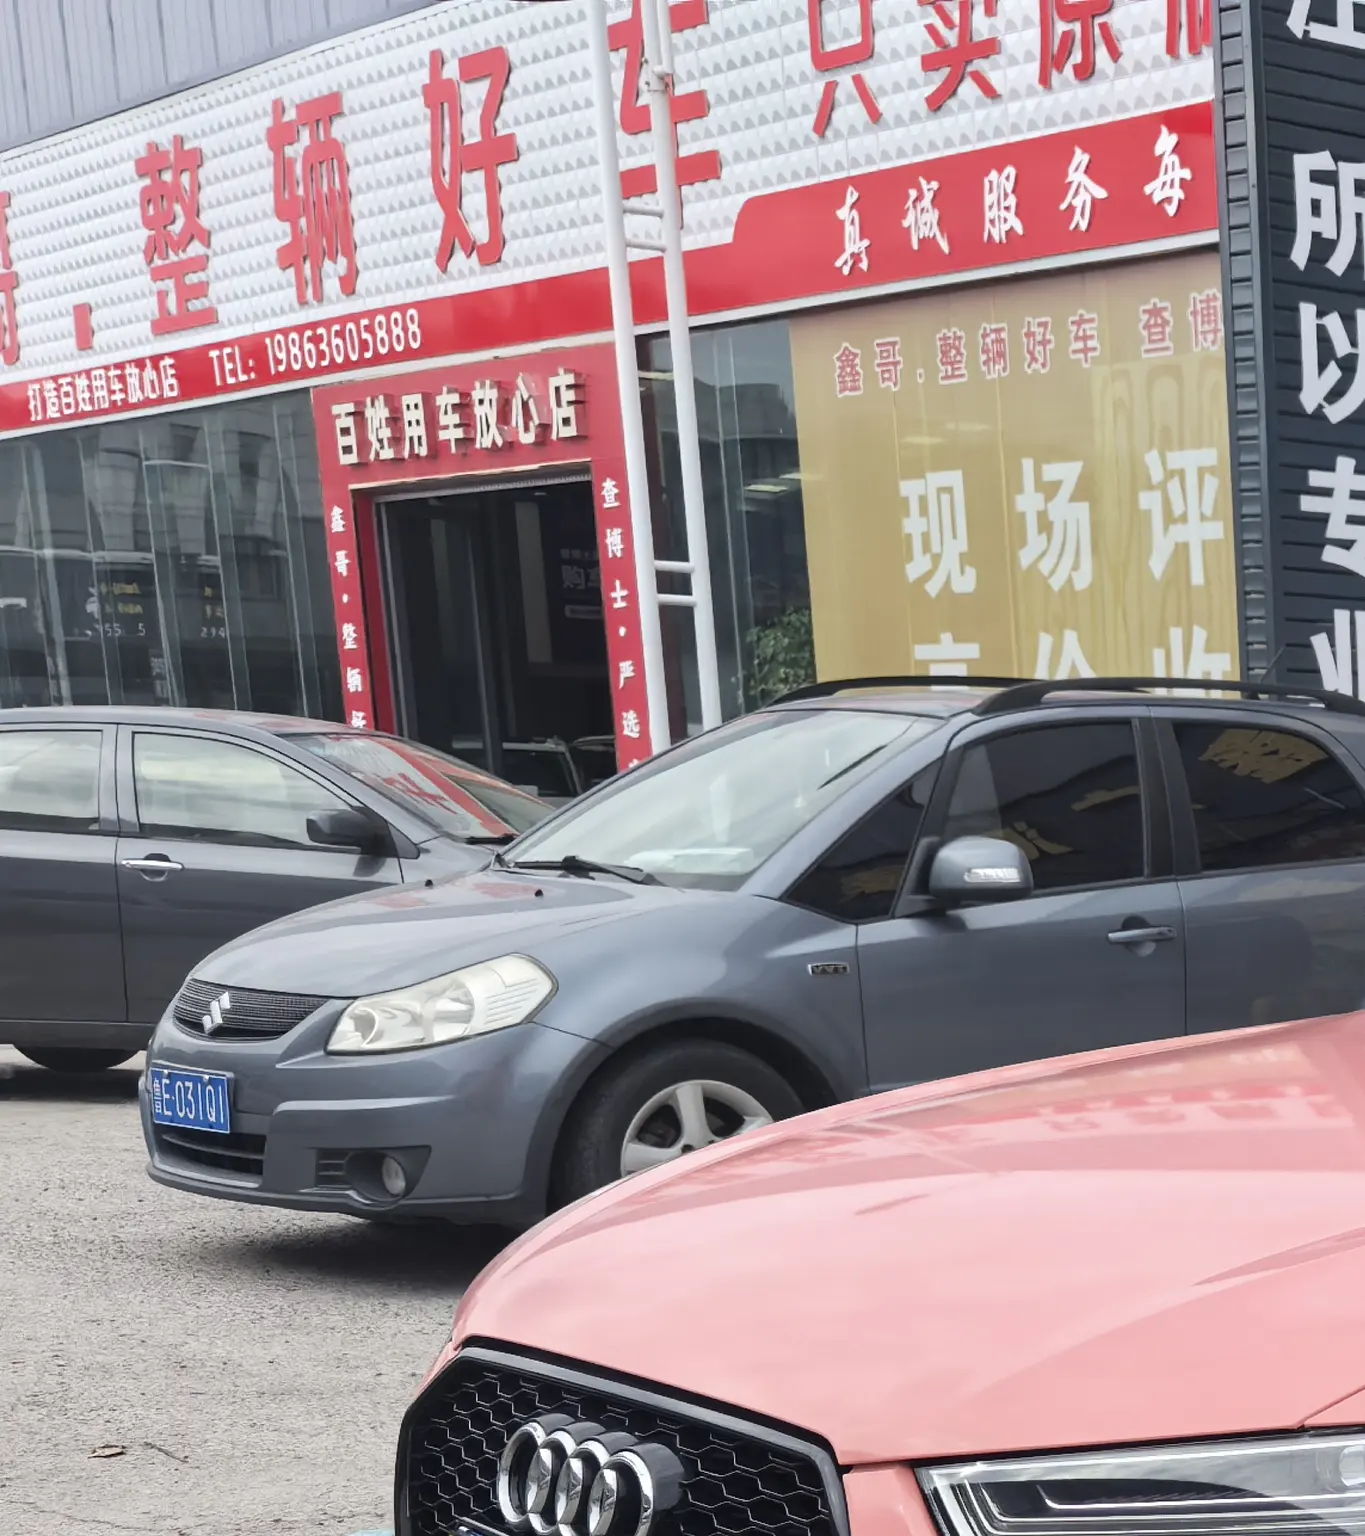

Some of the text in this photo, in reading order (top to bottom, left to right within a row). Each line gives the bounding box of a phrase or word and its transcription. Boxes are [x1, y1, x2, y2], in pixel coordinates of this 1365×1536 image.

[264, 307, 422, 377] 19863605888
[26, 357, 180, 422] 打造百姓用车放心店
[331, 367, 588, 467] 百姓用车放心店
